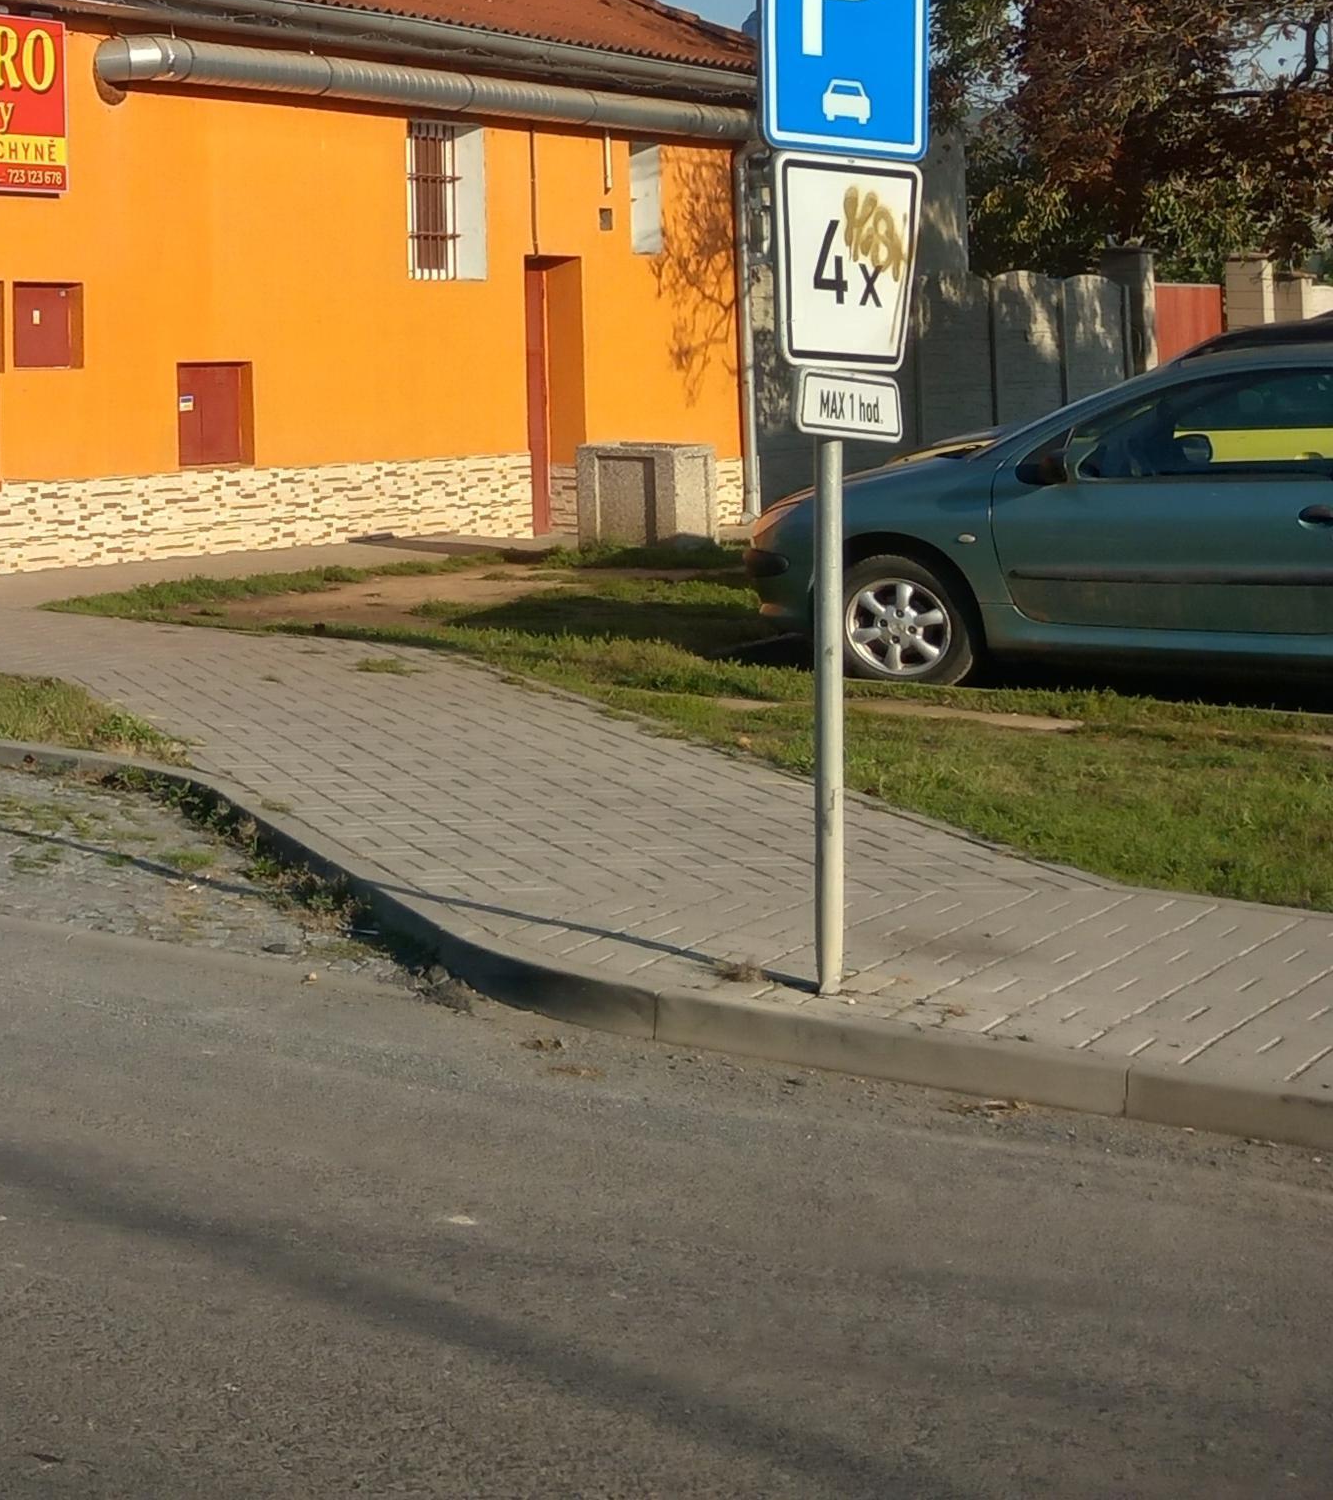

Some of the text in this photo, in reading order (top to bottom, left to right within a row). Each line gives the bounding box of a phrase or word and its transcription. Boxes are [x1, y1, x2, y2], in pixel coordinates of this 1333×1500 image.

[7, 168, 26, 183] 723
[27, 170, 43, 184] 123
[44, 171, 62, 186] 678
[819, 389, 884, 425] MAX 1 hod.
